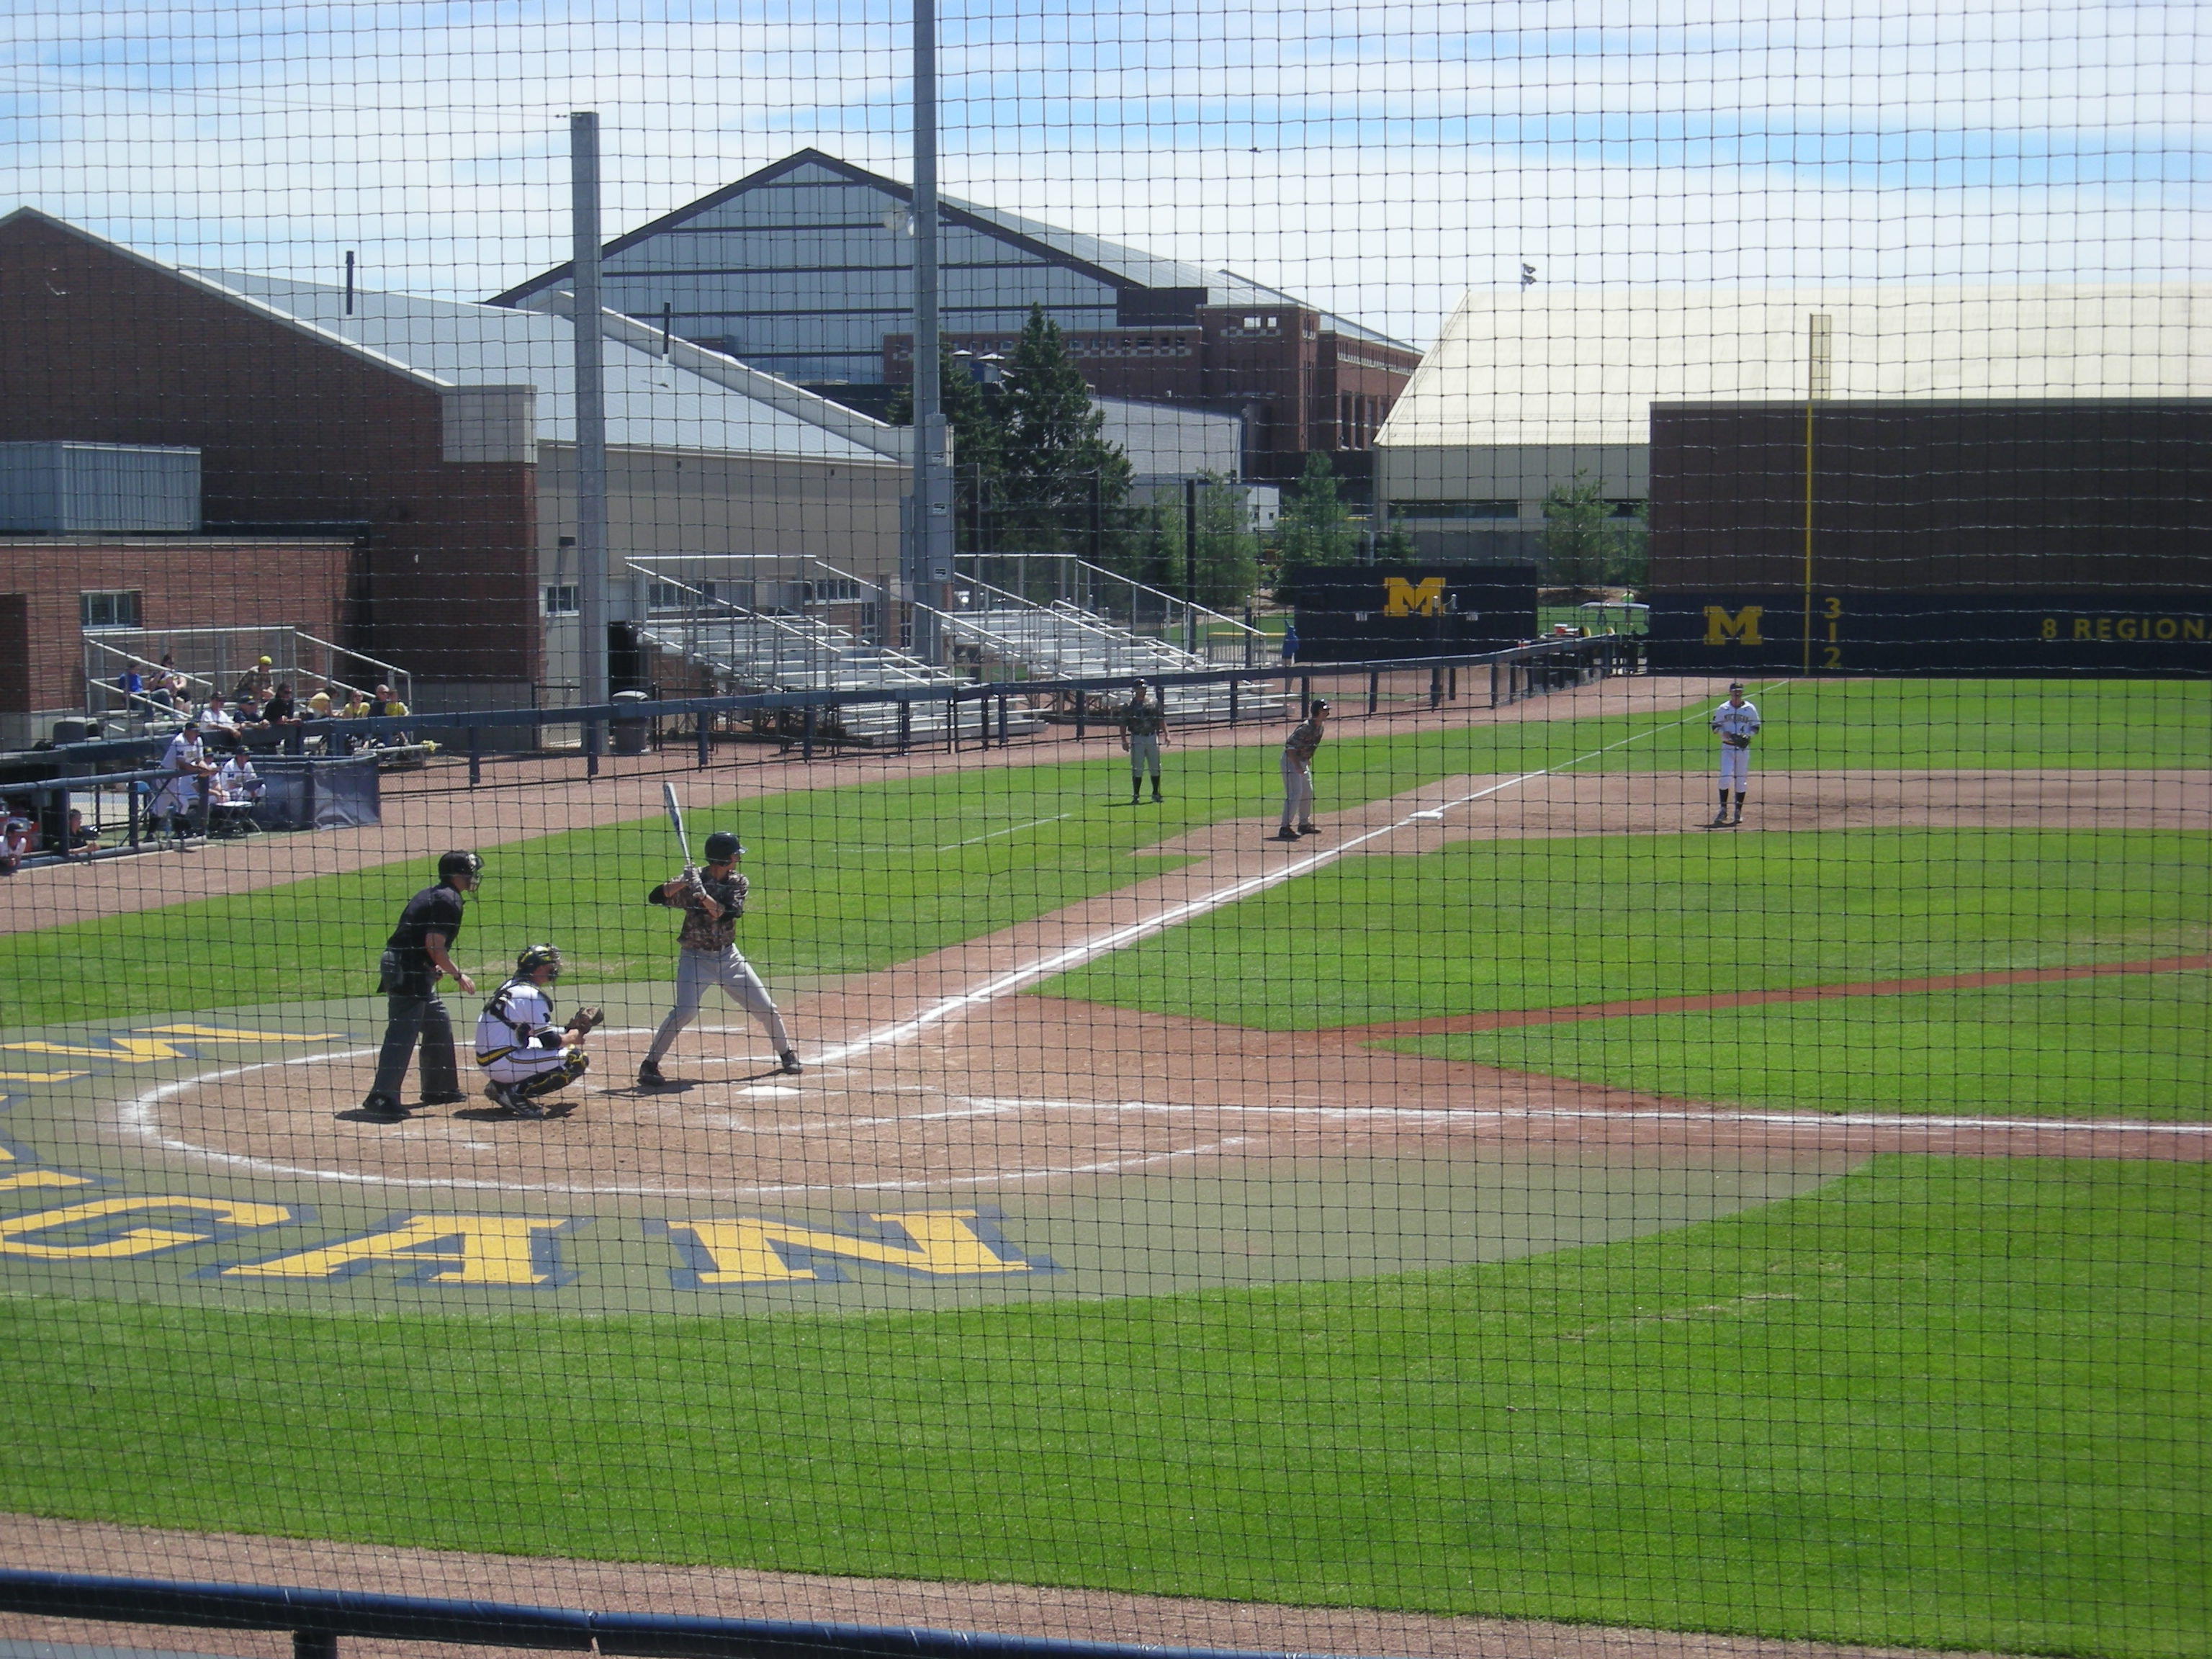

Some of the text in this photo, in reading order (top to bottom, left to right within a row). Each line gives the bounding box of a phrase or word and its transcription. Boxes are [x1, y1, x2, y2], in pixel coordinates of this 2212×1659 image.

[1383, 577, 1447, 617] M
[1703, 606, 1763, 645] M
[2042, 618, 2212, 639] 8 REGION
